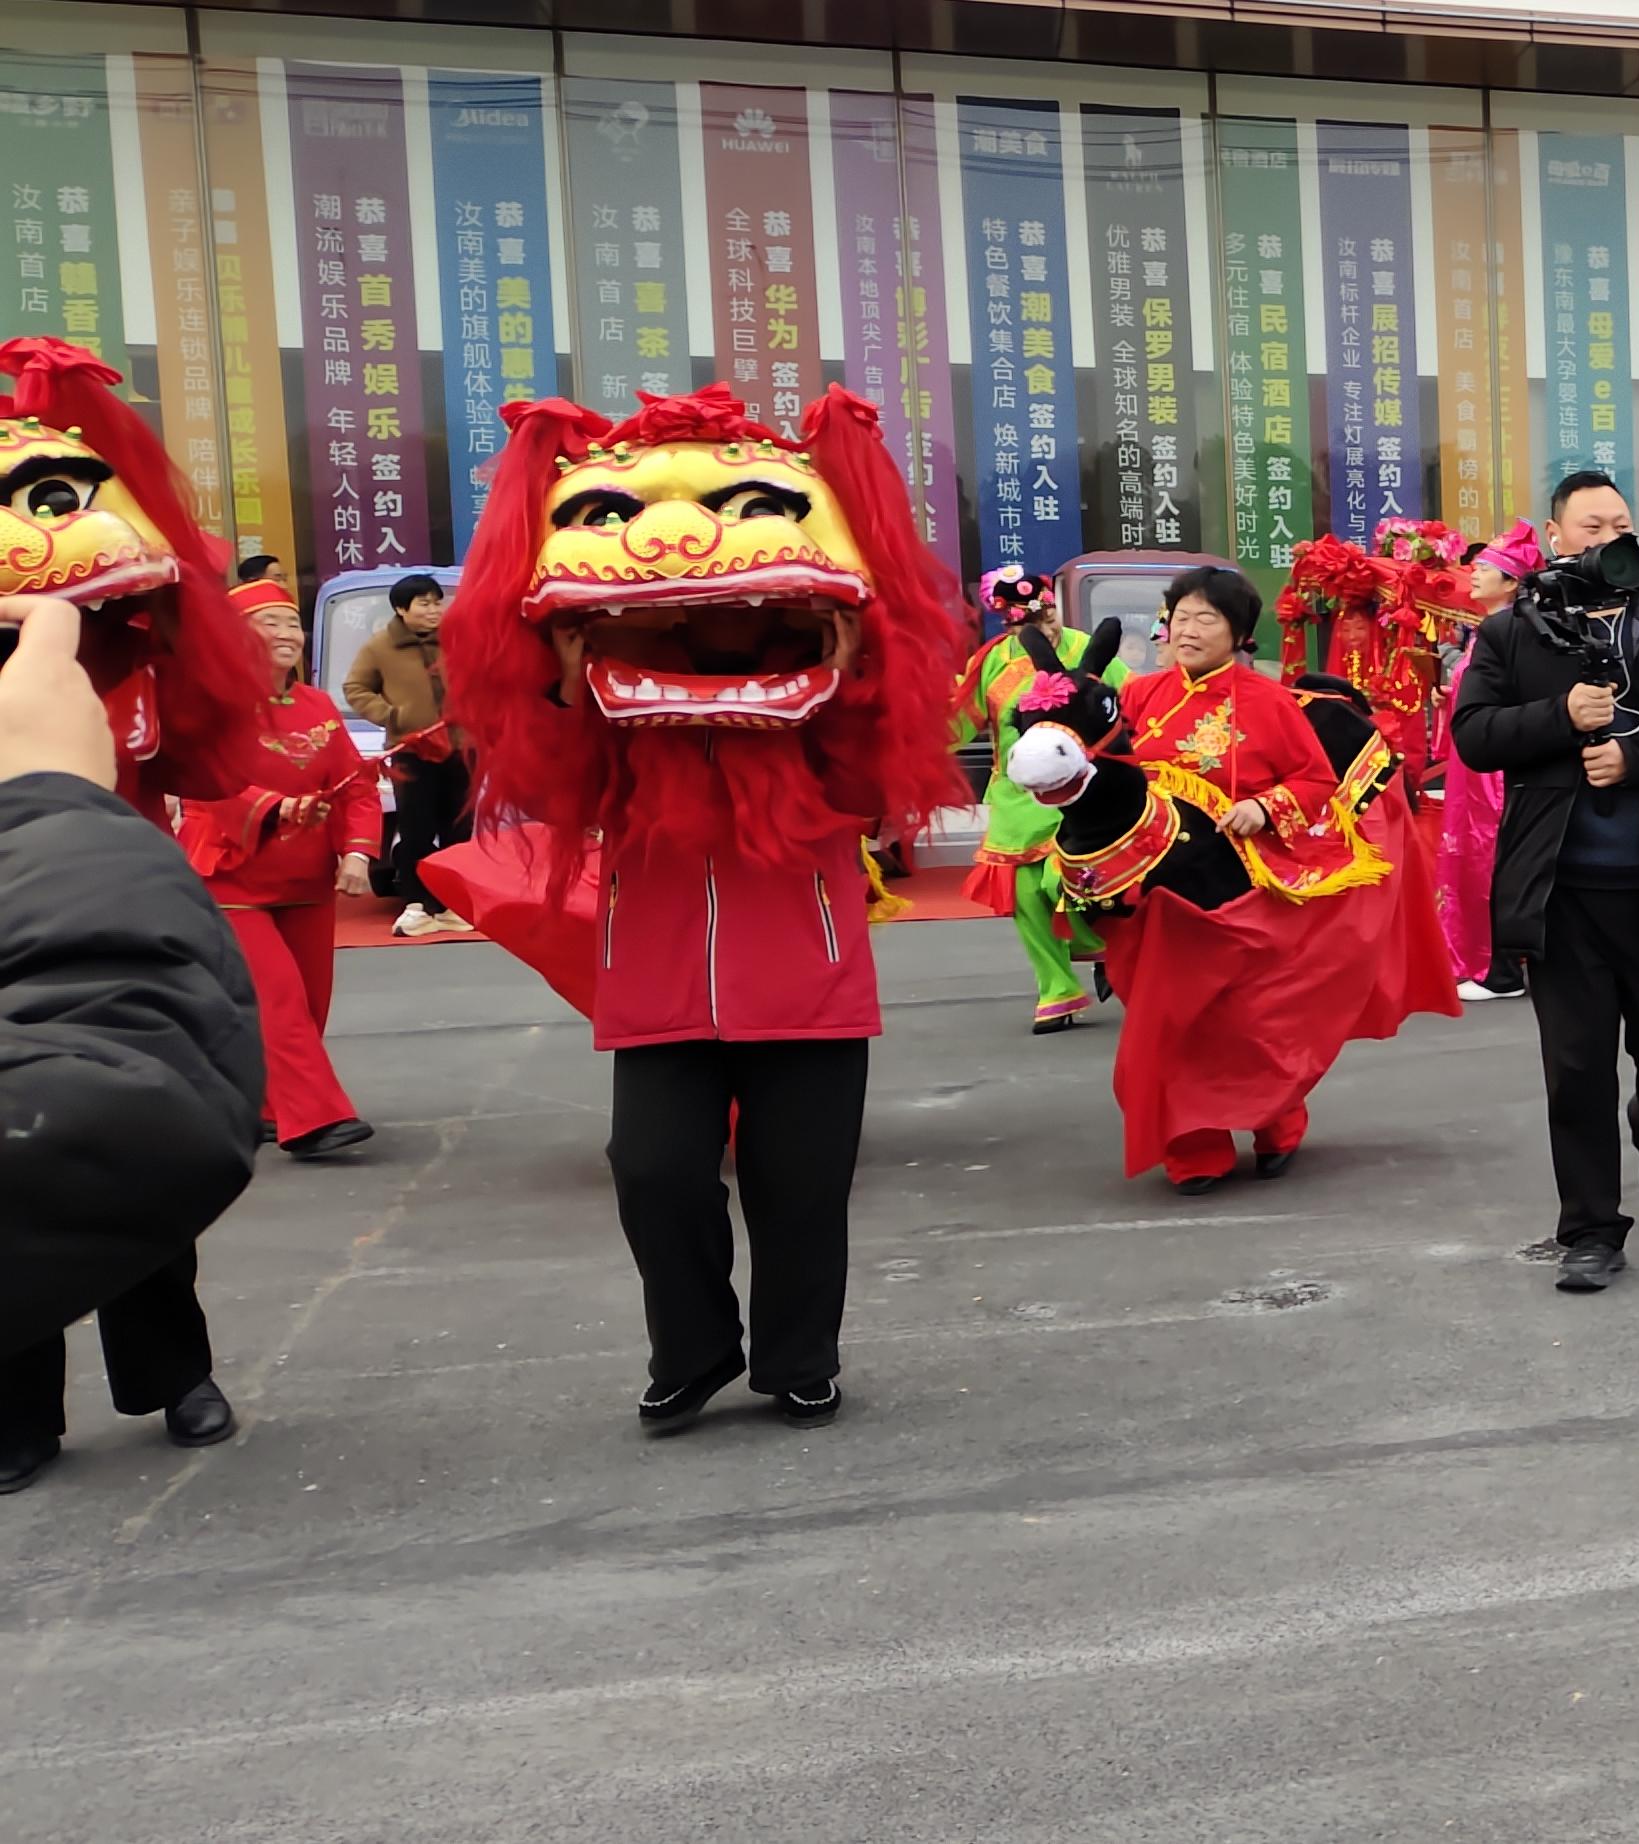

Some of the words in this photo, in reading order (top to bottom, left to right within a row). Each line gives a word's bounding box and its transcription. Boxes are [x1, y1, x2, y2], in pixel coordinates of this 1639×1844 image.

[722, 138, 790, 154] HUAWEI
[12, 184, 48, 313] 汝南首店
[312, 194, 353, 387] 潮流娱乐品牌
[455, 201, 496, 453] 汝南美的旗舰体验店
[592, 203, 625, 342] 汝南首店
[855, 213, 885, 423] 汝南本地顶尖广告制
[982, 216, 1016, 408] 特色餐饮集合店
[1105, 223, 1135, 328] 优雅男装
[1225, 231, 1250, 337] 多元住宿
[1337, 237, 1361, 369] 汝南标杆企业
[355, 197, 406, 569] 恭喜首秀娱乐签约入
[1018, 219, 1060, 521] 恭喜潮美食签约入驻
[1140, 226, 1181, 544] 恭喜保罗男装签约入驻
[1229, 350, 1260, 560] 体验特色美好时光
[1257, 234, 1294, 569] 恭喜民宿酒店签约入驻
[327, 407, 364, 566] 年轻人的休
[993, 422, 1025, 565] 焕新城市味
